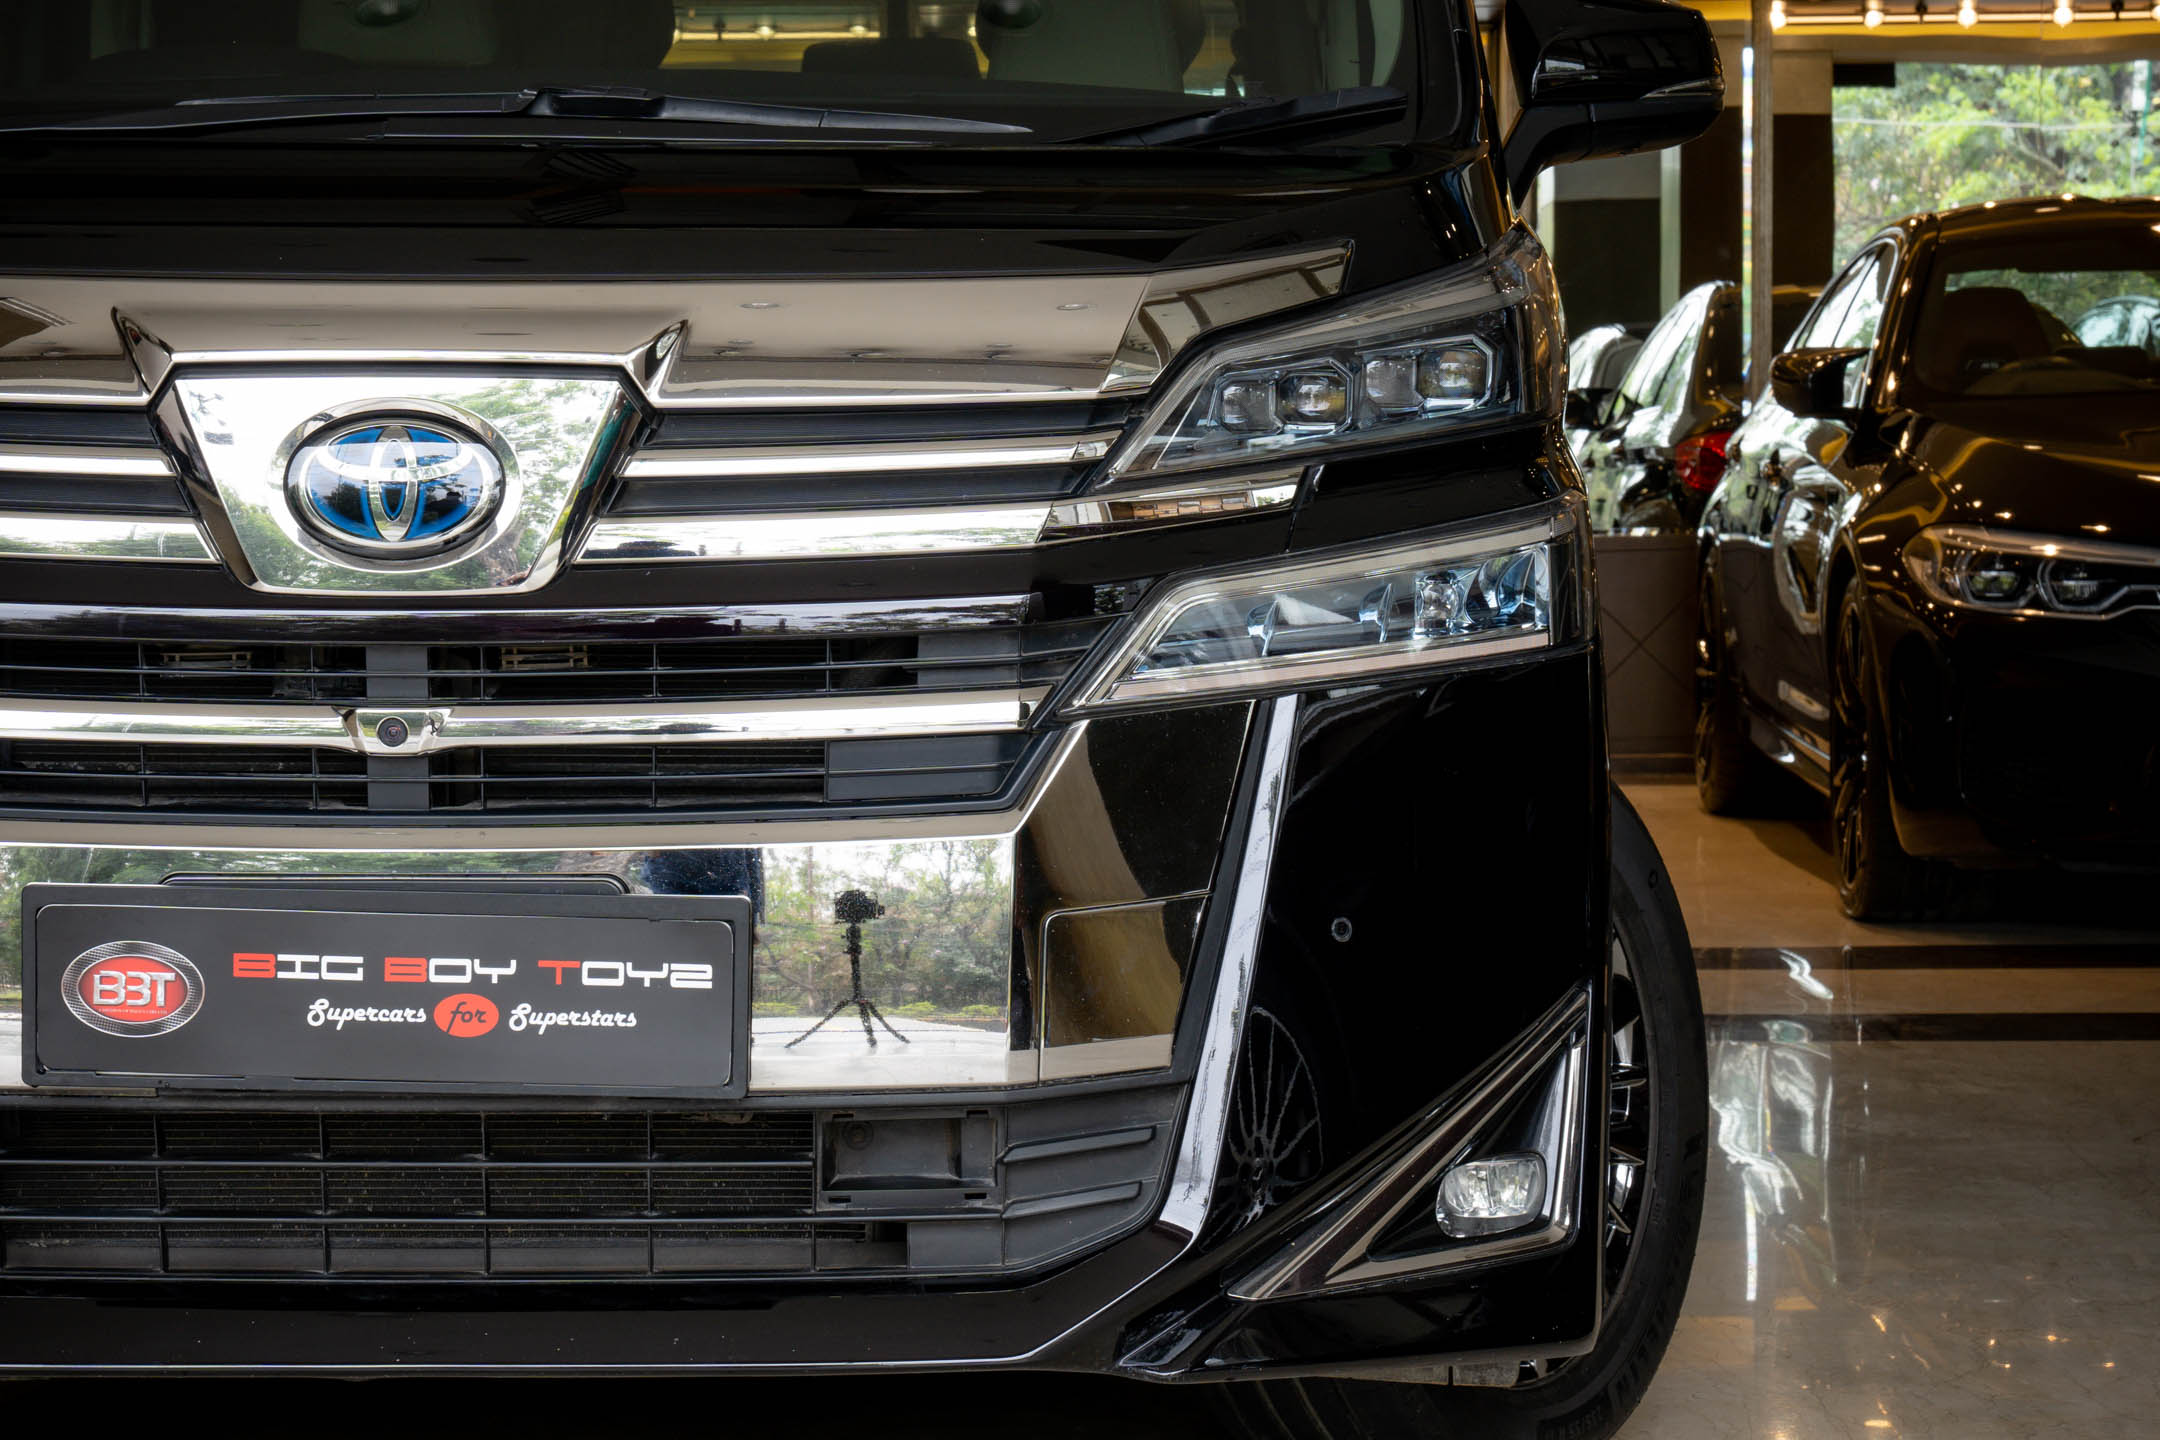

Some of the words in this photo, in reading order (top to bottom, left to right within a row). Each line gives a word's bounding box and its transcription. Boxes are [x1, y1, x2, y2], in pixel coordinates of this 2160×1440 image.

[232, 952, 365, 982] BIG
[384, 956, 517, 984] BOY
[306, 998, 427, 1031] Supercars
[446, 1000, 488, 1034] for
[508, 1003, 638, 1036] Superstars
